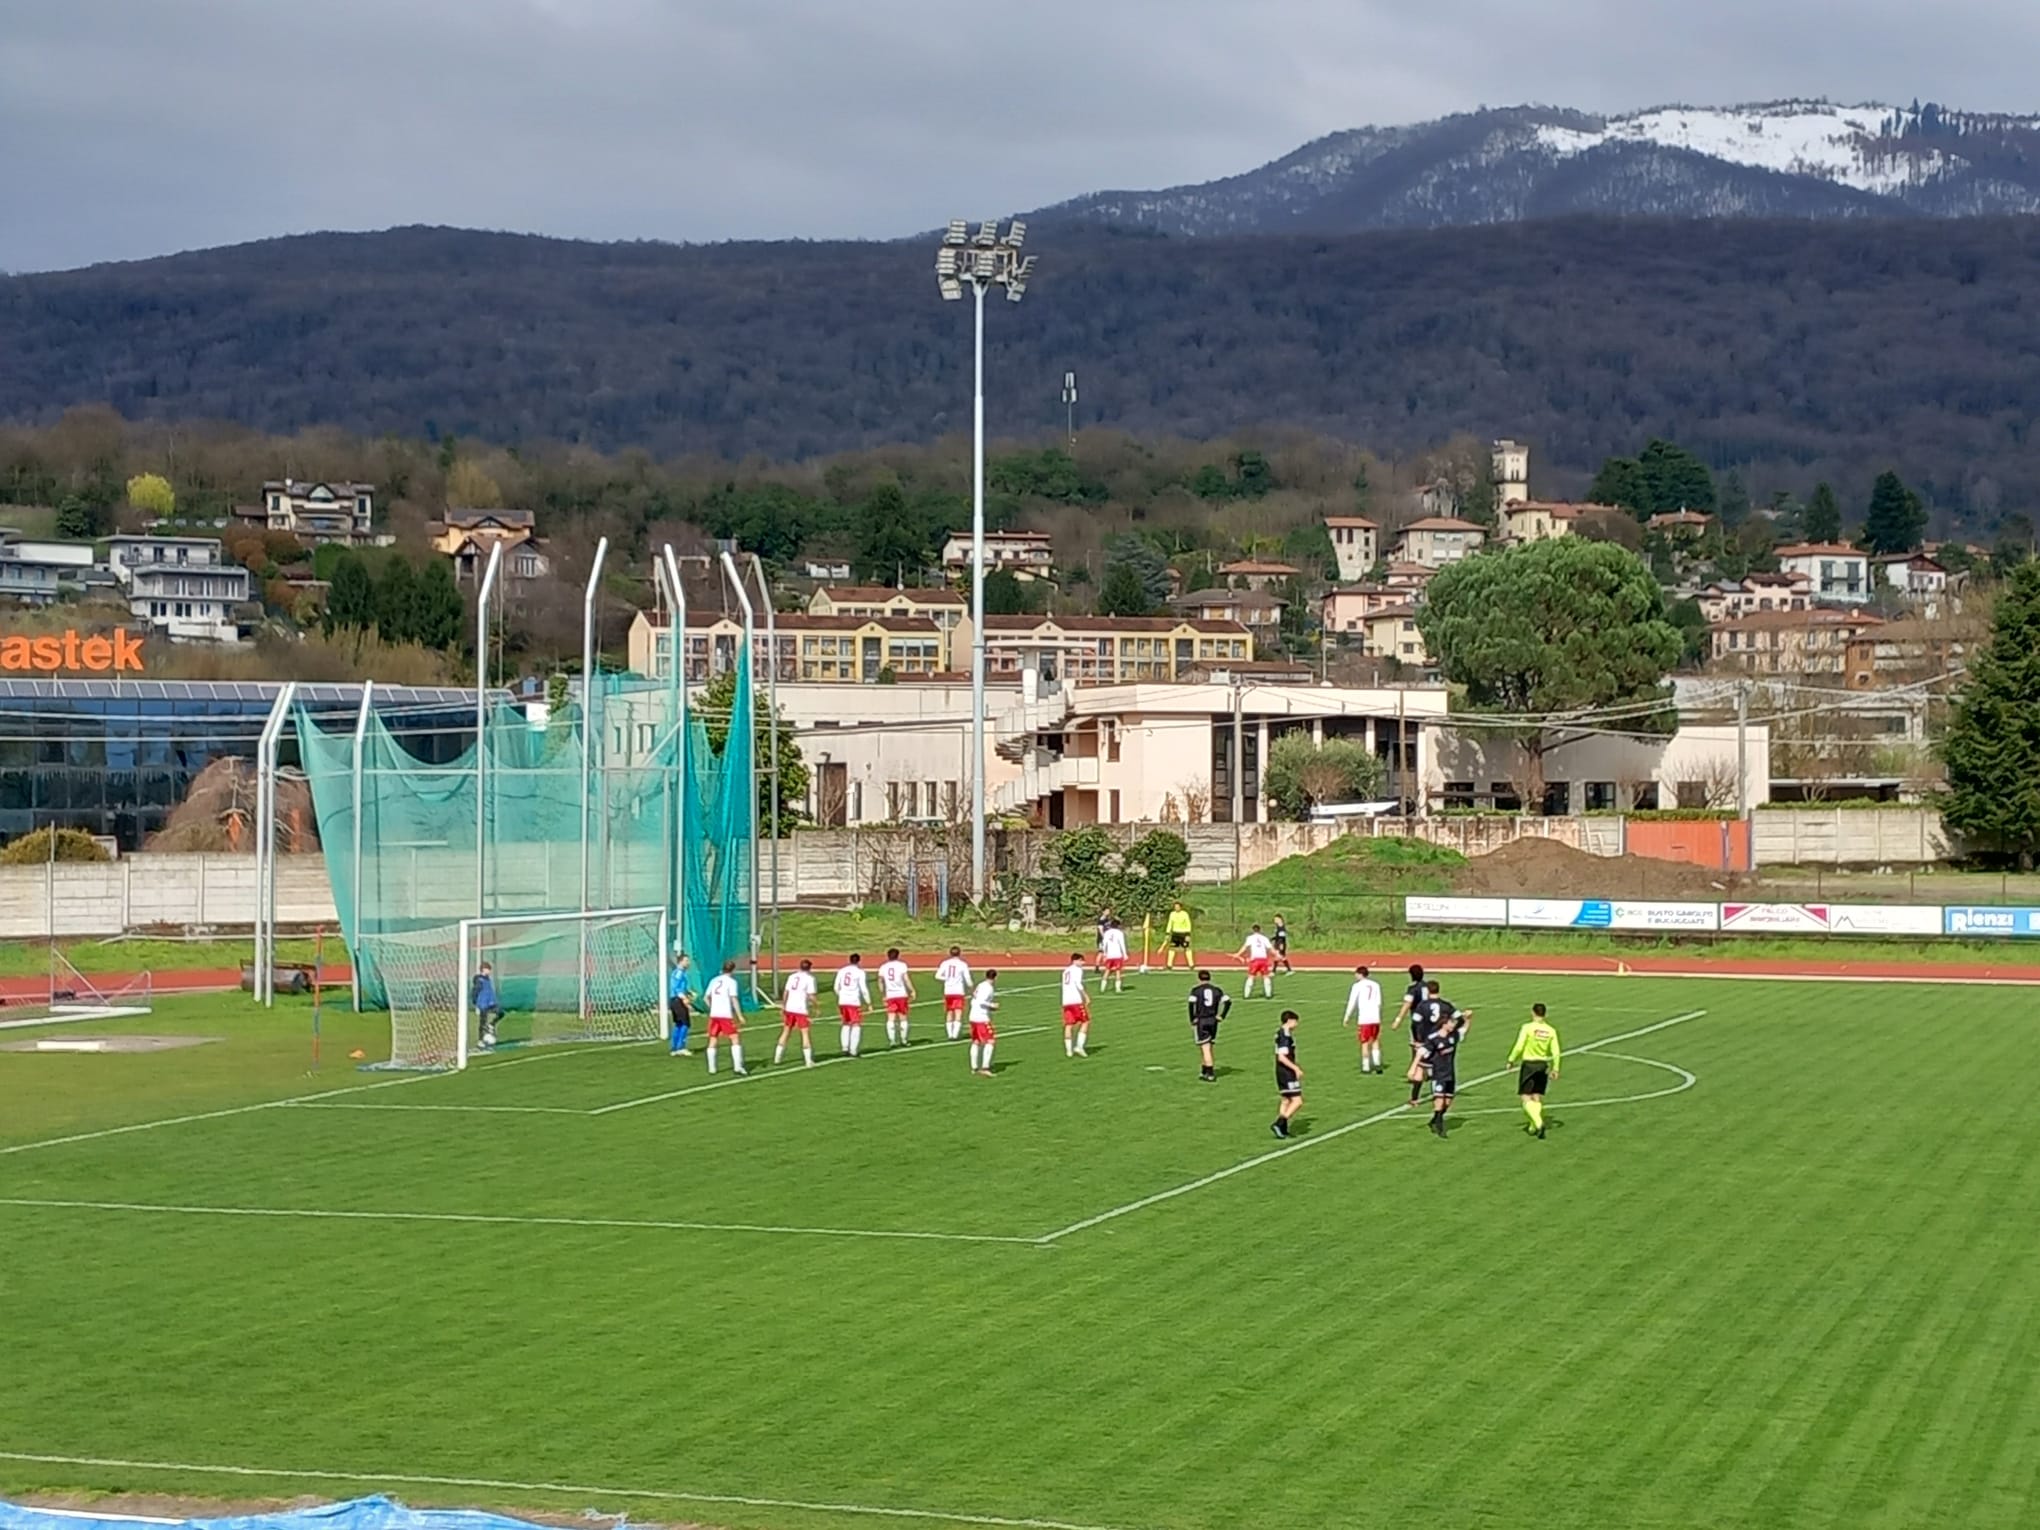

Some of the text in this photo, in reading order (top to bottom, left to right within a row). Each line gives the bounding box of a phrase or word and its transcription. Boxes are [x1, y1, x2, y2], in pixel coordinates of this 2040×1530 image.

[0, 628, 144, 670] astek
[888, 967, 895, 981] 9
[948, 965, 956, 978] 11
[791, 976, 800, 990] 3
[843, 972, 852, 987] 6
[714, 980, 723, 995] 2
[1366, 984, 1373, 1001] 7
[1203, 988, 1213, 1007] 9
[1430, 1003, 1441, 1023] 3
